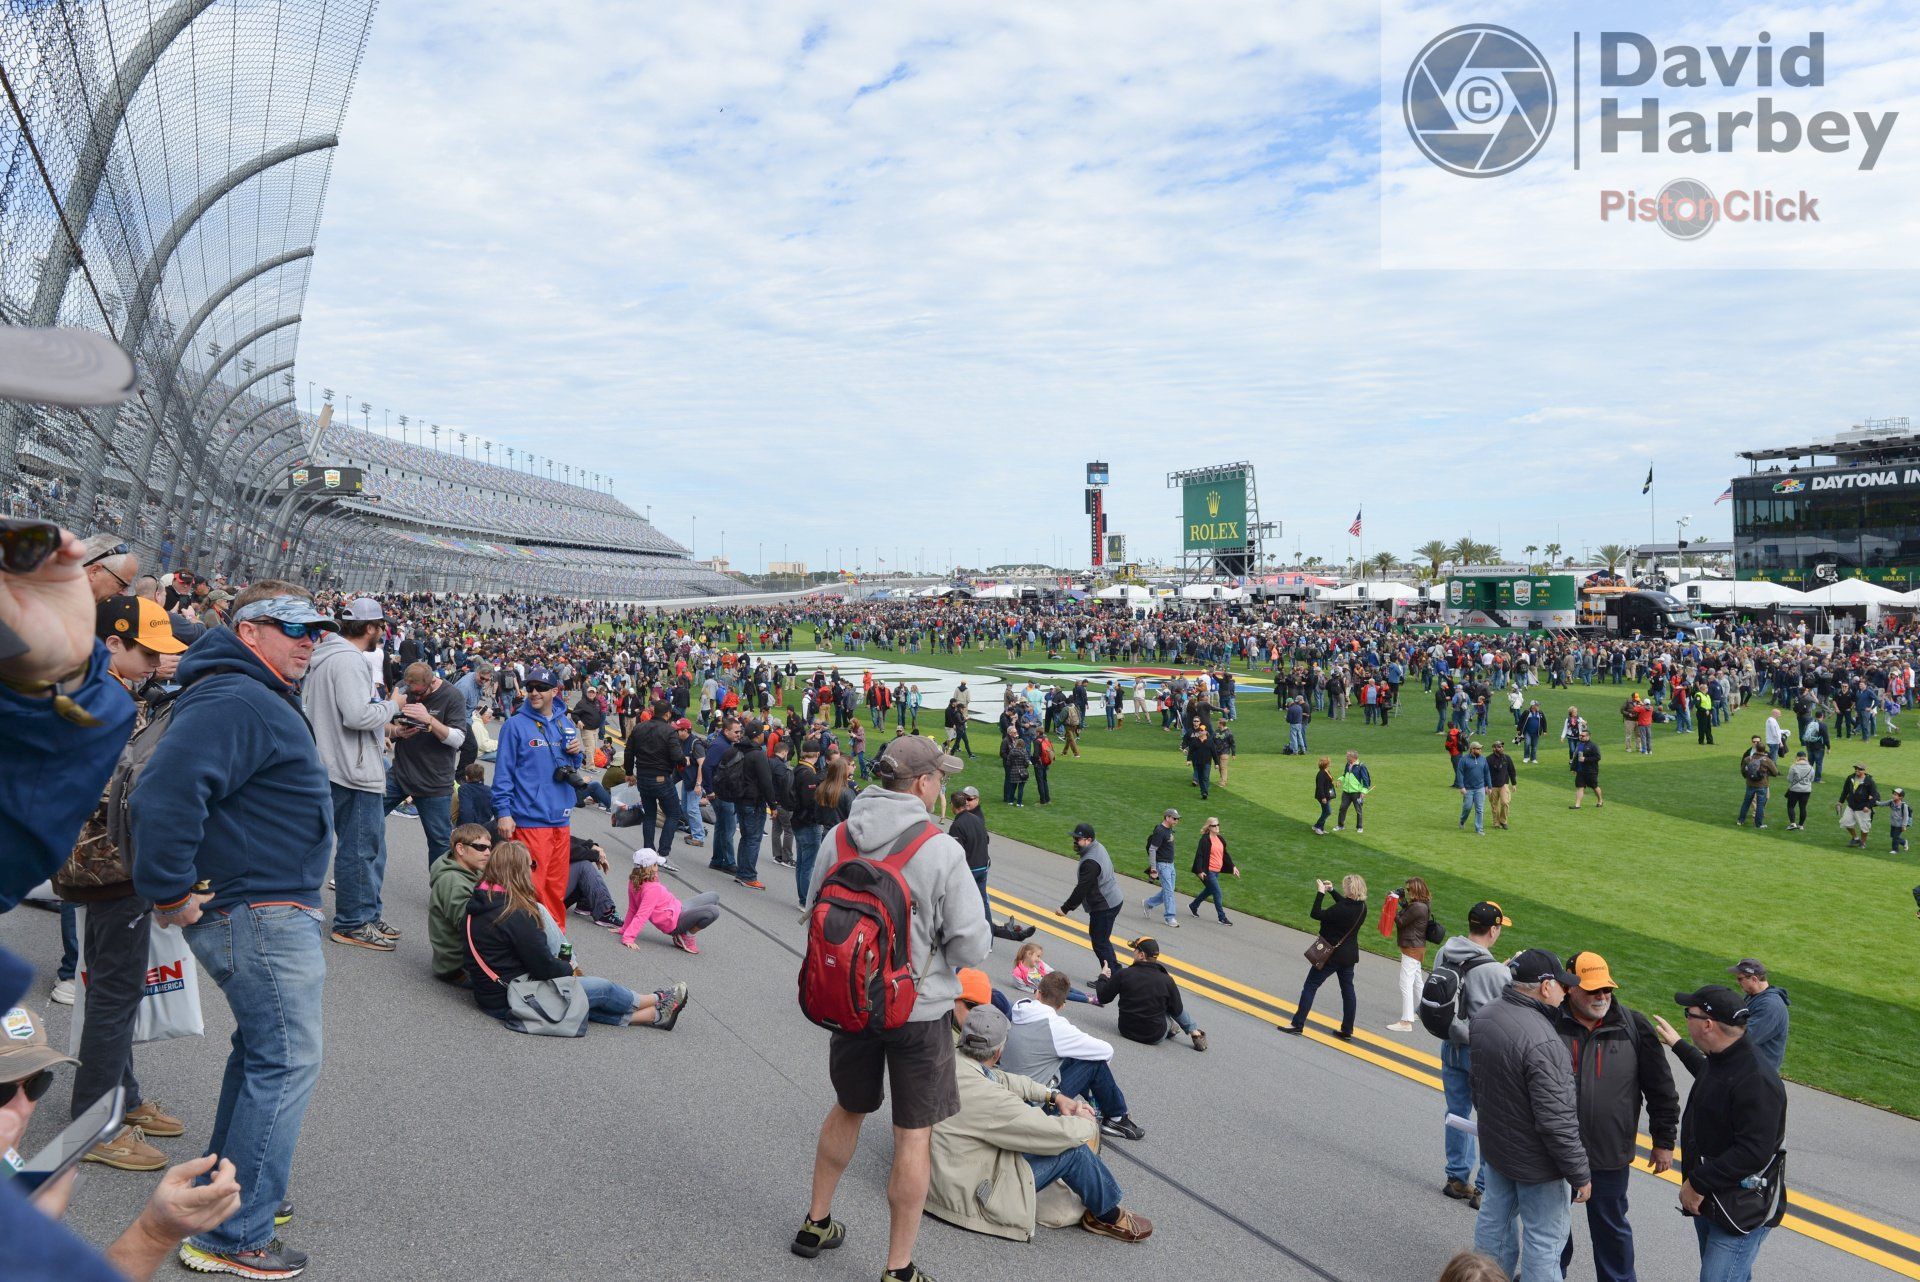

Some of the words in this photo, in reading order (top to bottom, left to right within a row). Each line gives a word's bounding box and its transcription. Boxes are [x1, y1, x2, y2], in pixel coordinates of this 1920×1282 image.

[1811, 471, 1898, 491] DAYTONA
[1190, 521, 1239, 541] ROLEX
[154, 981, 183, 993] AMERICA
